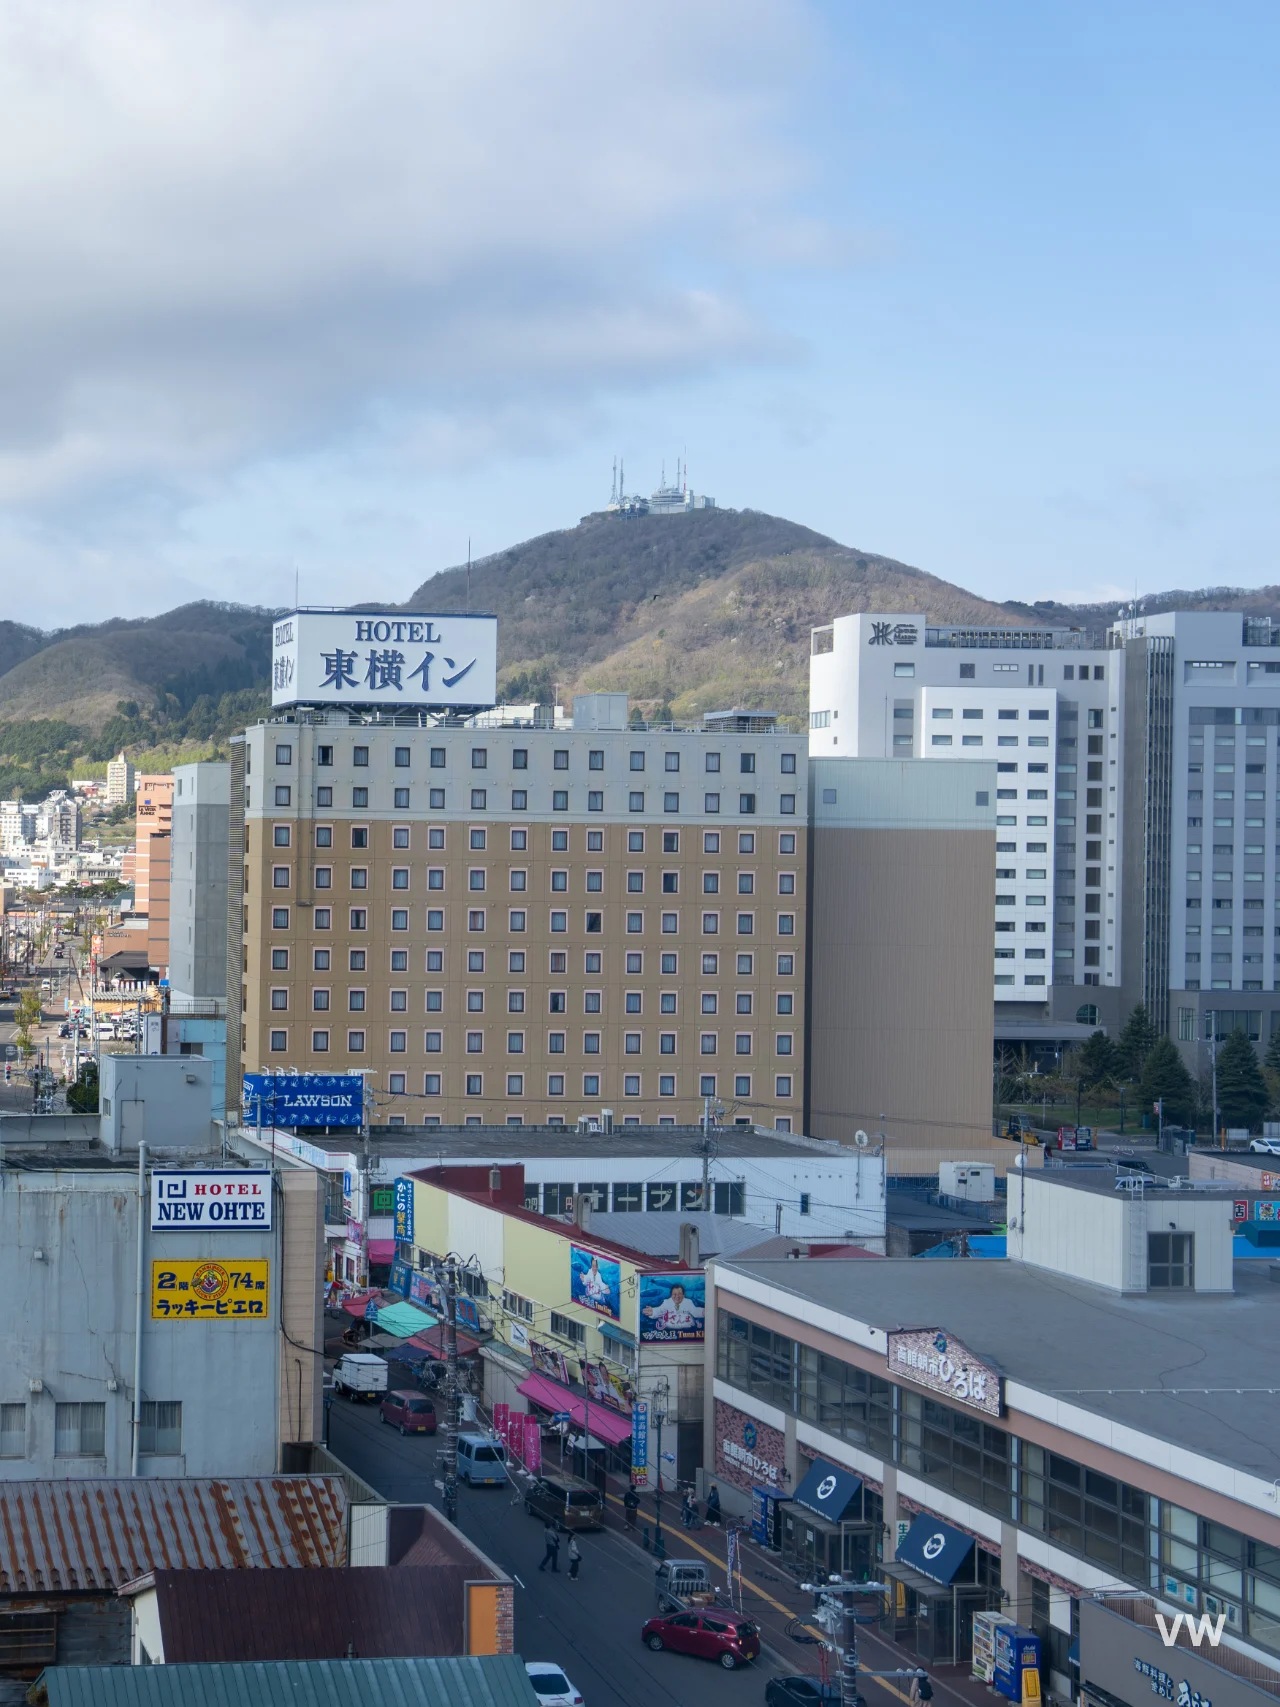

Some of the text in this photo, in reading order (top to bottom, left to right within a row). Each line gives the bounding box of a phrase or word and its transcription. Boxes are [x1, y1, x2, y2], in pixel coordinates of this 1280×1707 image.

[274, 621, 294, 648] HOTEL
[355, 620, 441, 643] HOTEL
[273, 655, 295, 692] 東横イン
[319, 648, 477, 691] 東横イン
[283, 1094, 353, 1107] LAWSON
[194, 1183, 262, 1196] HOTEL
[158, 1201, 265, 1221] NEW OHTE
[156, 1298, 263, 1315] ラッキーピエロ
[677, 1330, 695, 1339] Tuna
[897, 1345, 987, 1400] 函館朝市ひろば
[723, 1439, 778, 1480] 函館朝市ひろば
[1133, 1657, 1174, 1689] 海鮮料理と
